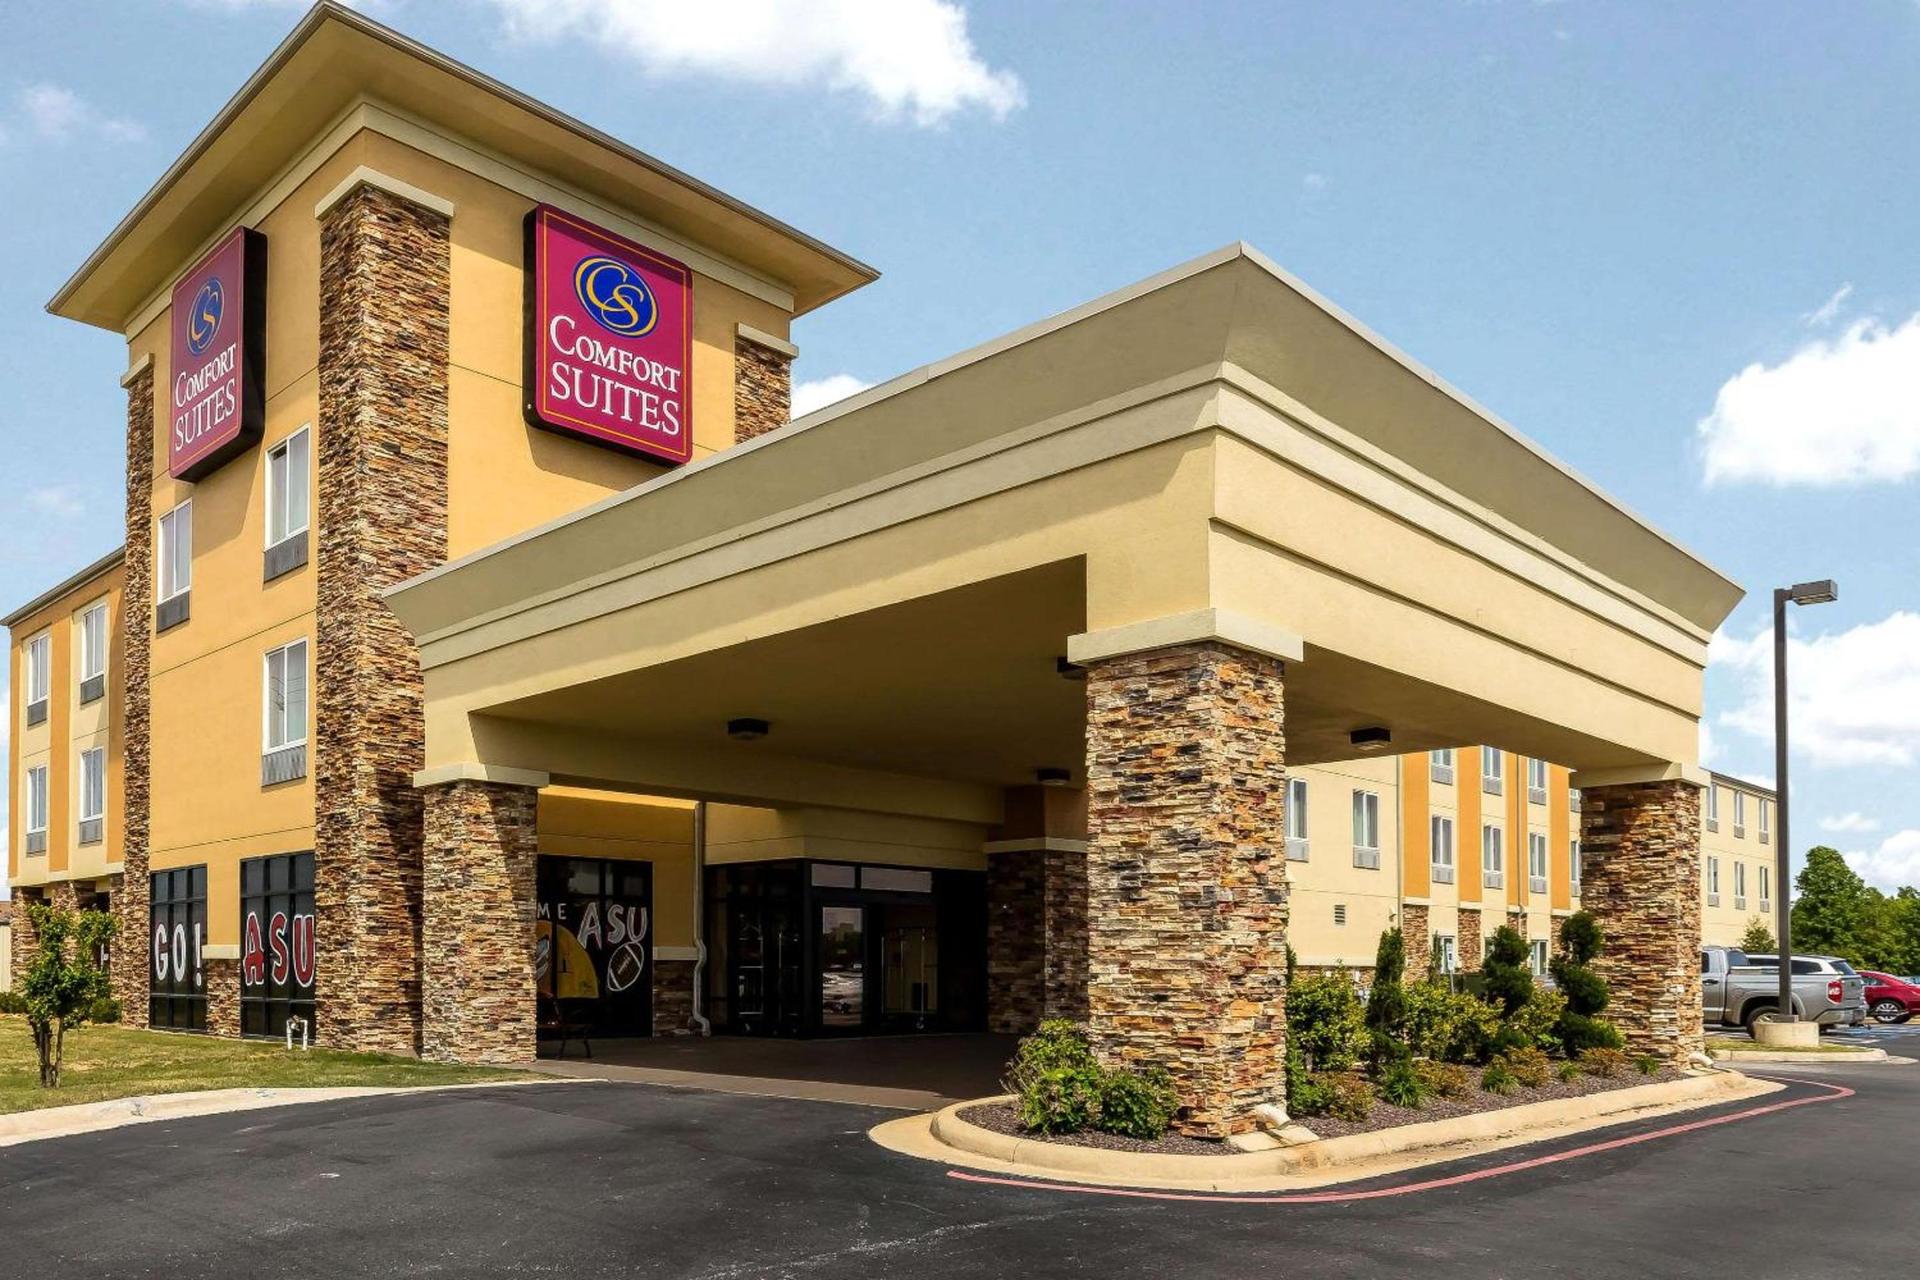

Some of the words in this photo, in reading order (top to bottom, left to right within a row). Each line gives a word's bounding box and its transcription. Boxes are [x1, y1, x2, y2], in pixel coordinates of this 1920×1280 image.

[175, 342, 236, 408] COMFORT
[550, 315, 681, 393] COMFORT
[175, 377, 235, 451] SUITES
[551, 361, 679, 436] SUITES
[155, 922, 202, 986] GO!
[243, 911, 315, 988] ASU
[577, 901, 648, 950] ASU
